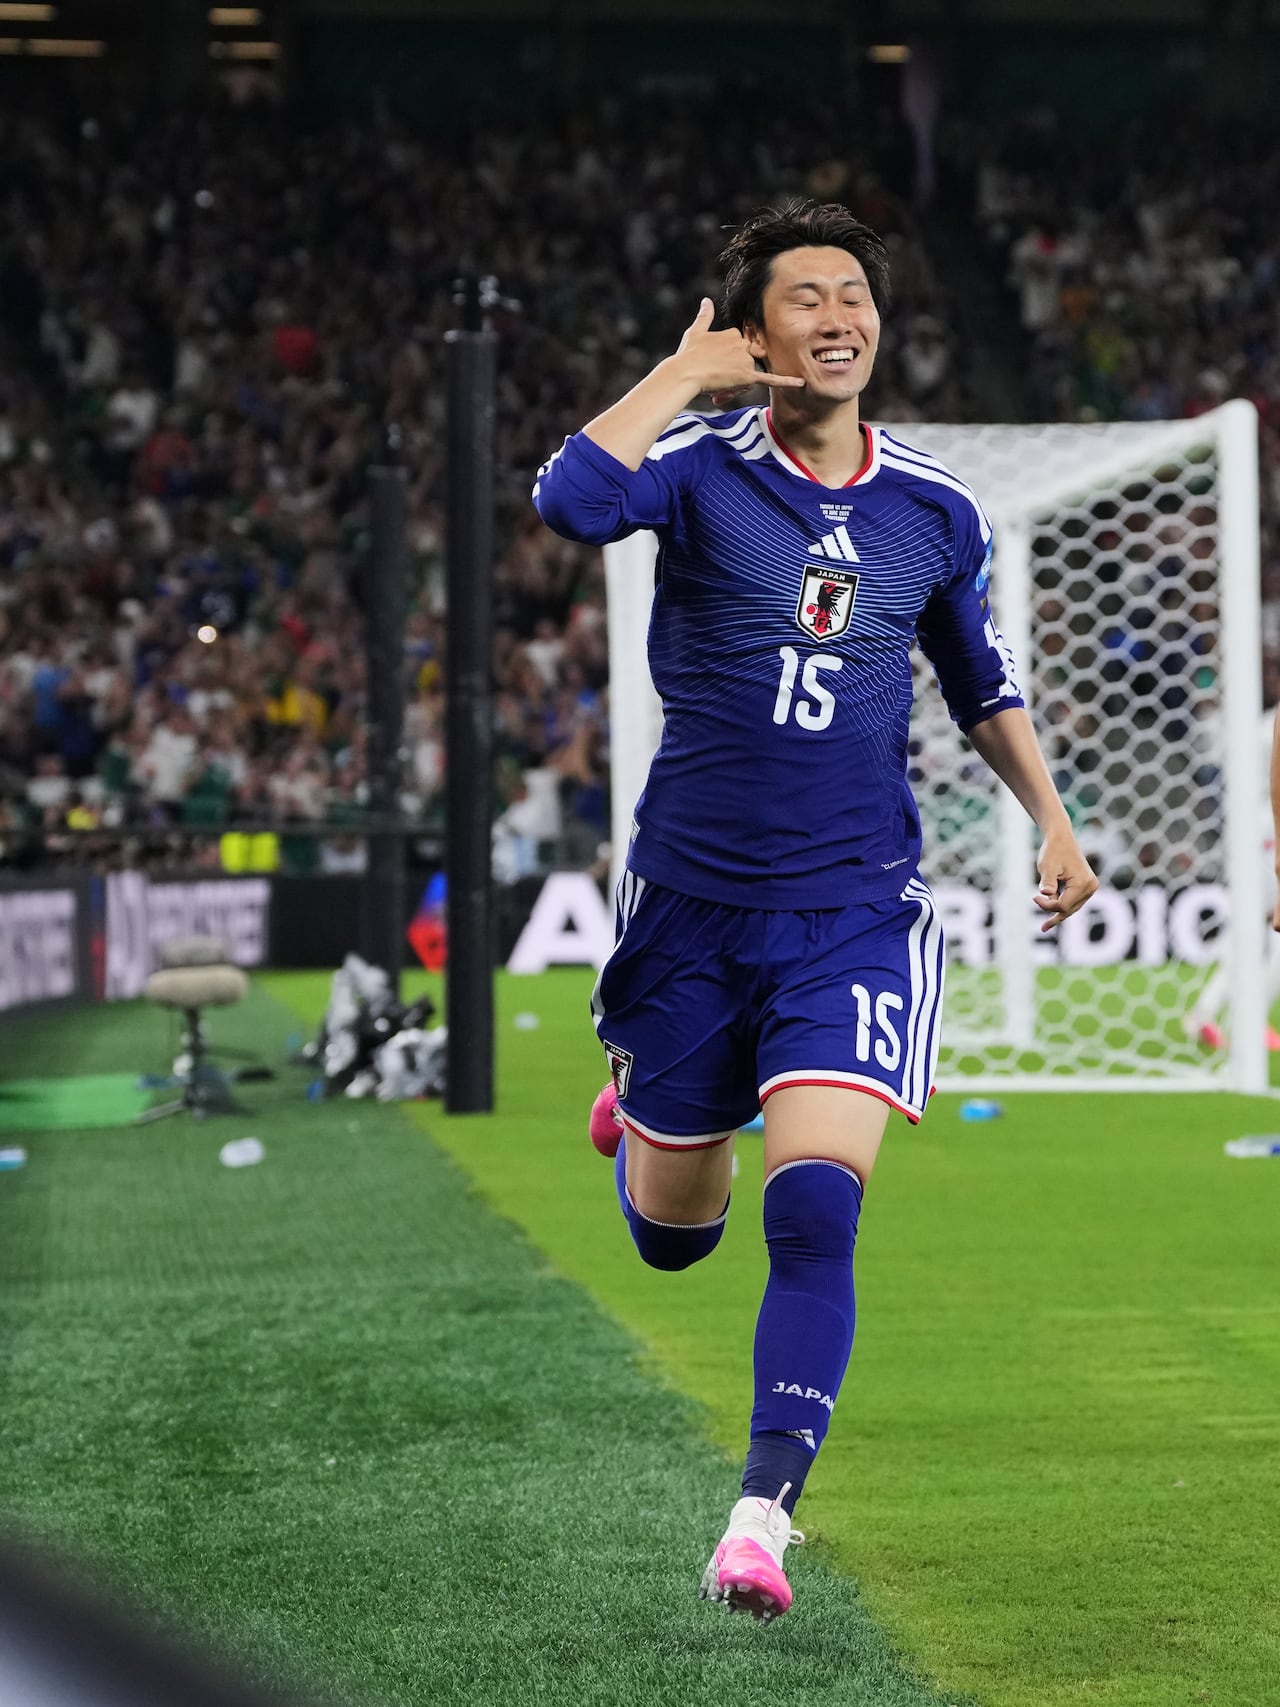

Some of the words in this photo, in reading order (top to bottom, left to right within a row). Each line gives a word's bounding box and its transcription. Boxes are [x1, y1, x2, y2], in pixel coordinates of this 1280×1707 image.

[817, 570, 846, 581] JAPAN
[809, 616, 833, 631] JFA
[772, 645, 843, 732] 15
[851, 983, 904, 1072] 15
[609, 1046, 627, 1059] JAPAN
